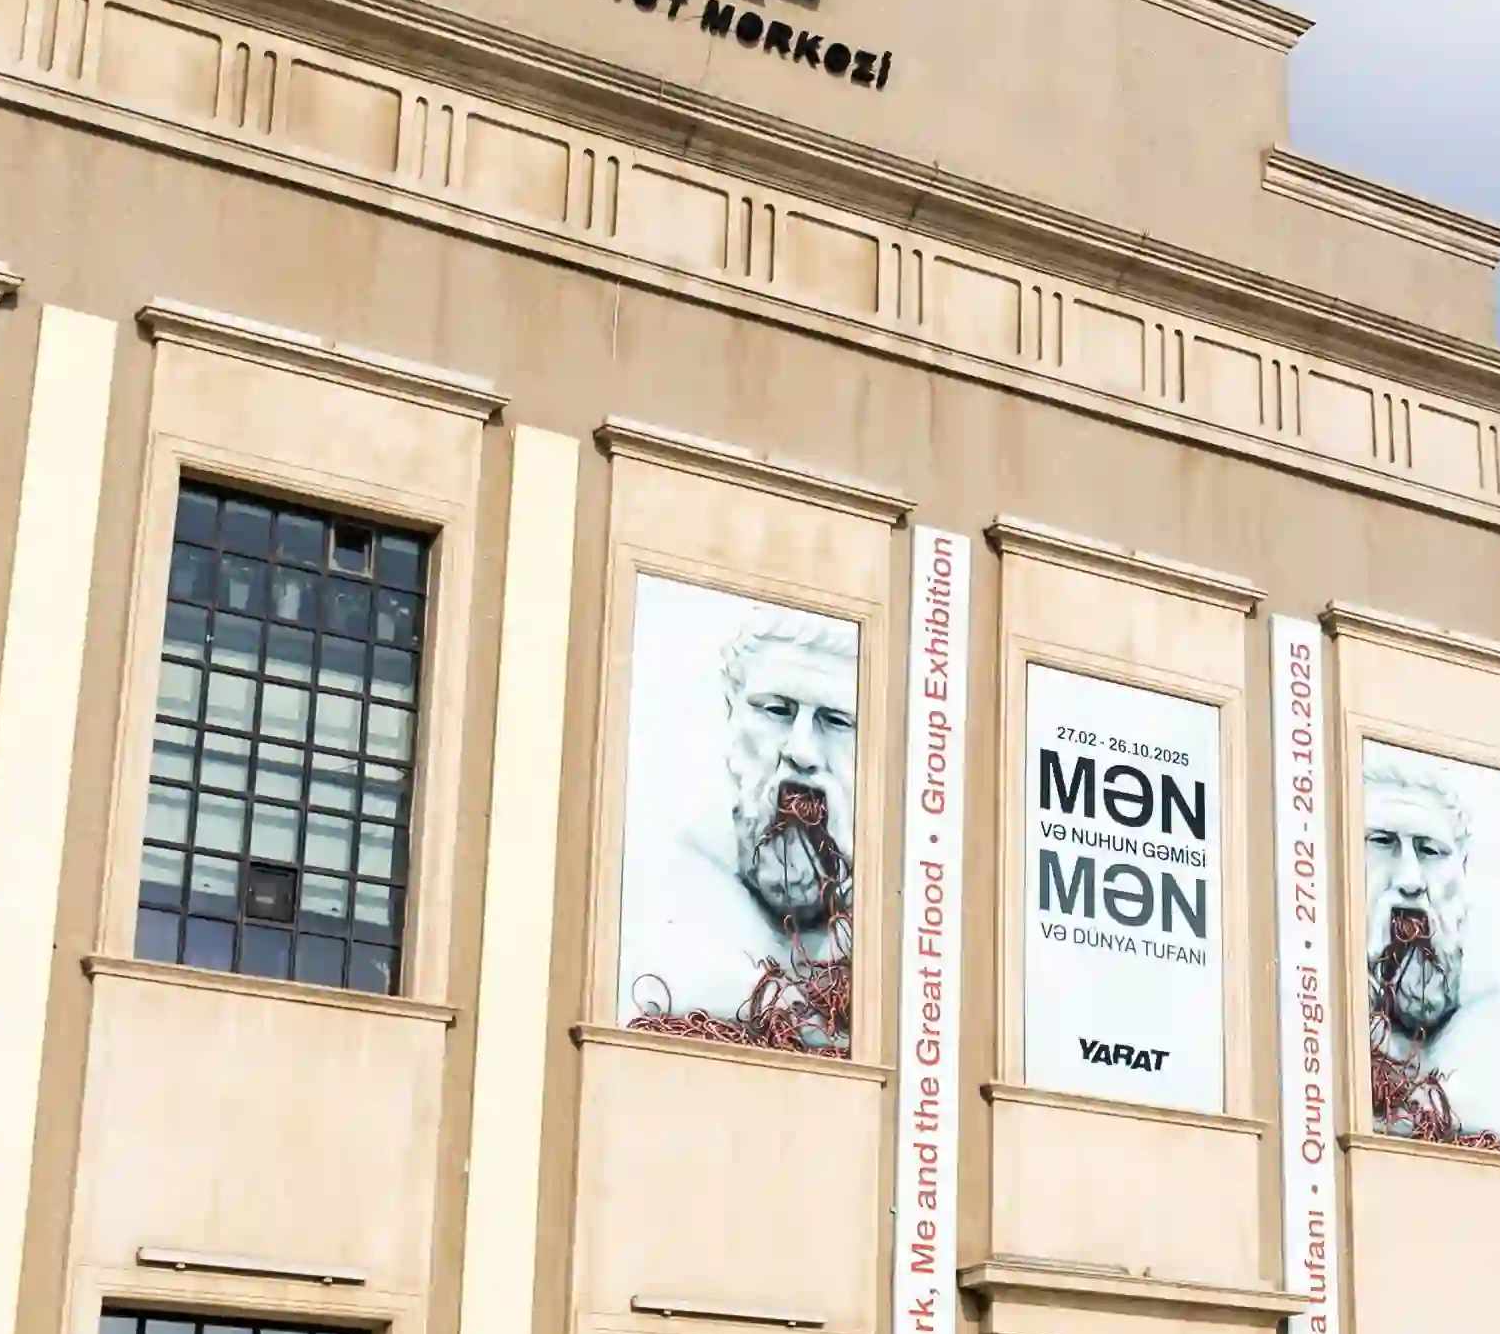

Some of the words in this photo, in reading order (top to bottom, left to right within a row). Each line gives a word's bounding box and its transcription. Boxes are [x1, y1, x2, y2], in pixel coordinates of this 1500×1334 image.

[924, 538, 952, 701] Exhibition
[922, 711, 952, 814] Group
[1057, 726, 1097, 747] 27.02
[1109, 737, 1190, 767] 26.10.2025
[1290, 643, 1313, 813] 26.10.2025
[1039, 747, 1206, 841] MƏN
[1040, 821, 1067, 841] VƏ
[1072, 827, 1138, 855] NUHUN
[1143, 842, 1206, 868] GƏMİSİ
[1294, 840, 1315, 923] 27.02
[918, 861, 944, 958] Flood
[1039, 848, 1206, 939] MƏN
[1040, 922, 1067, 941] VƏ
[1073, 926, 1137, 954] DÜNYA
[1142, 940, 1206, 967] TUFANI
[916, 967, 942, 1066] Great
[1078, 1036, 1170, 1072] YARAT
[914, 1077, 939, 1132] the
[1302, 1084, 1325, 1164] Qrup
[913, 1143, 938, 1210] and
[911, 1220, 936, 1274] Me
